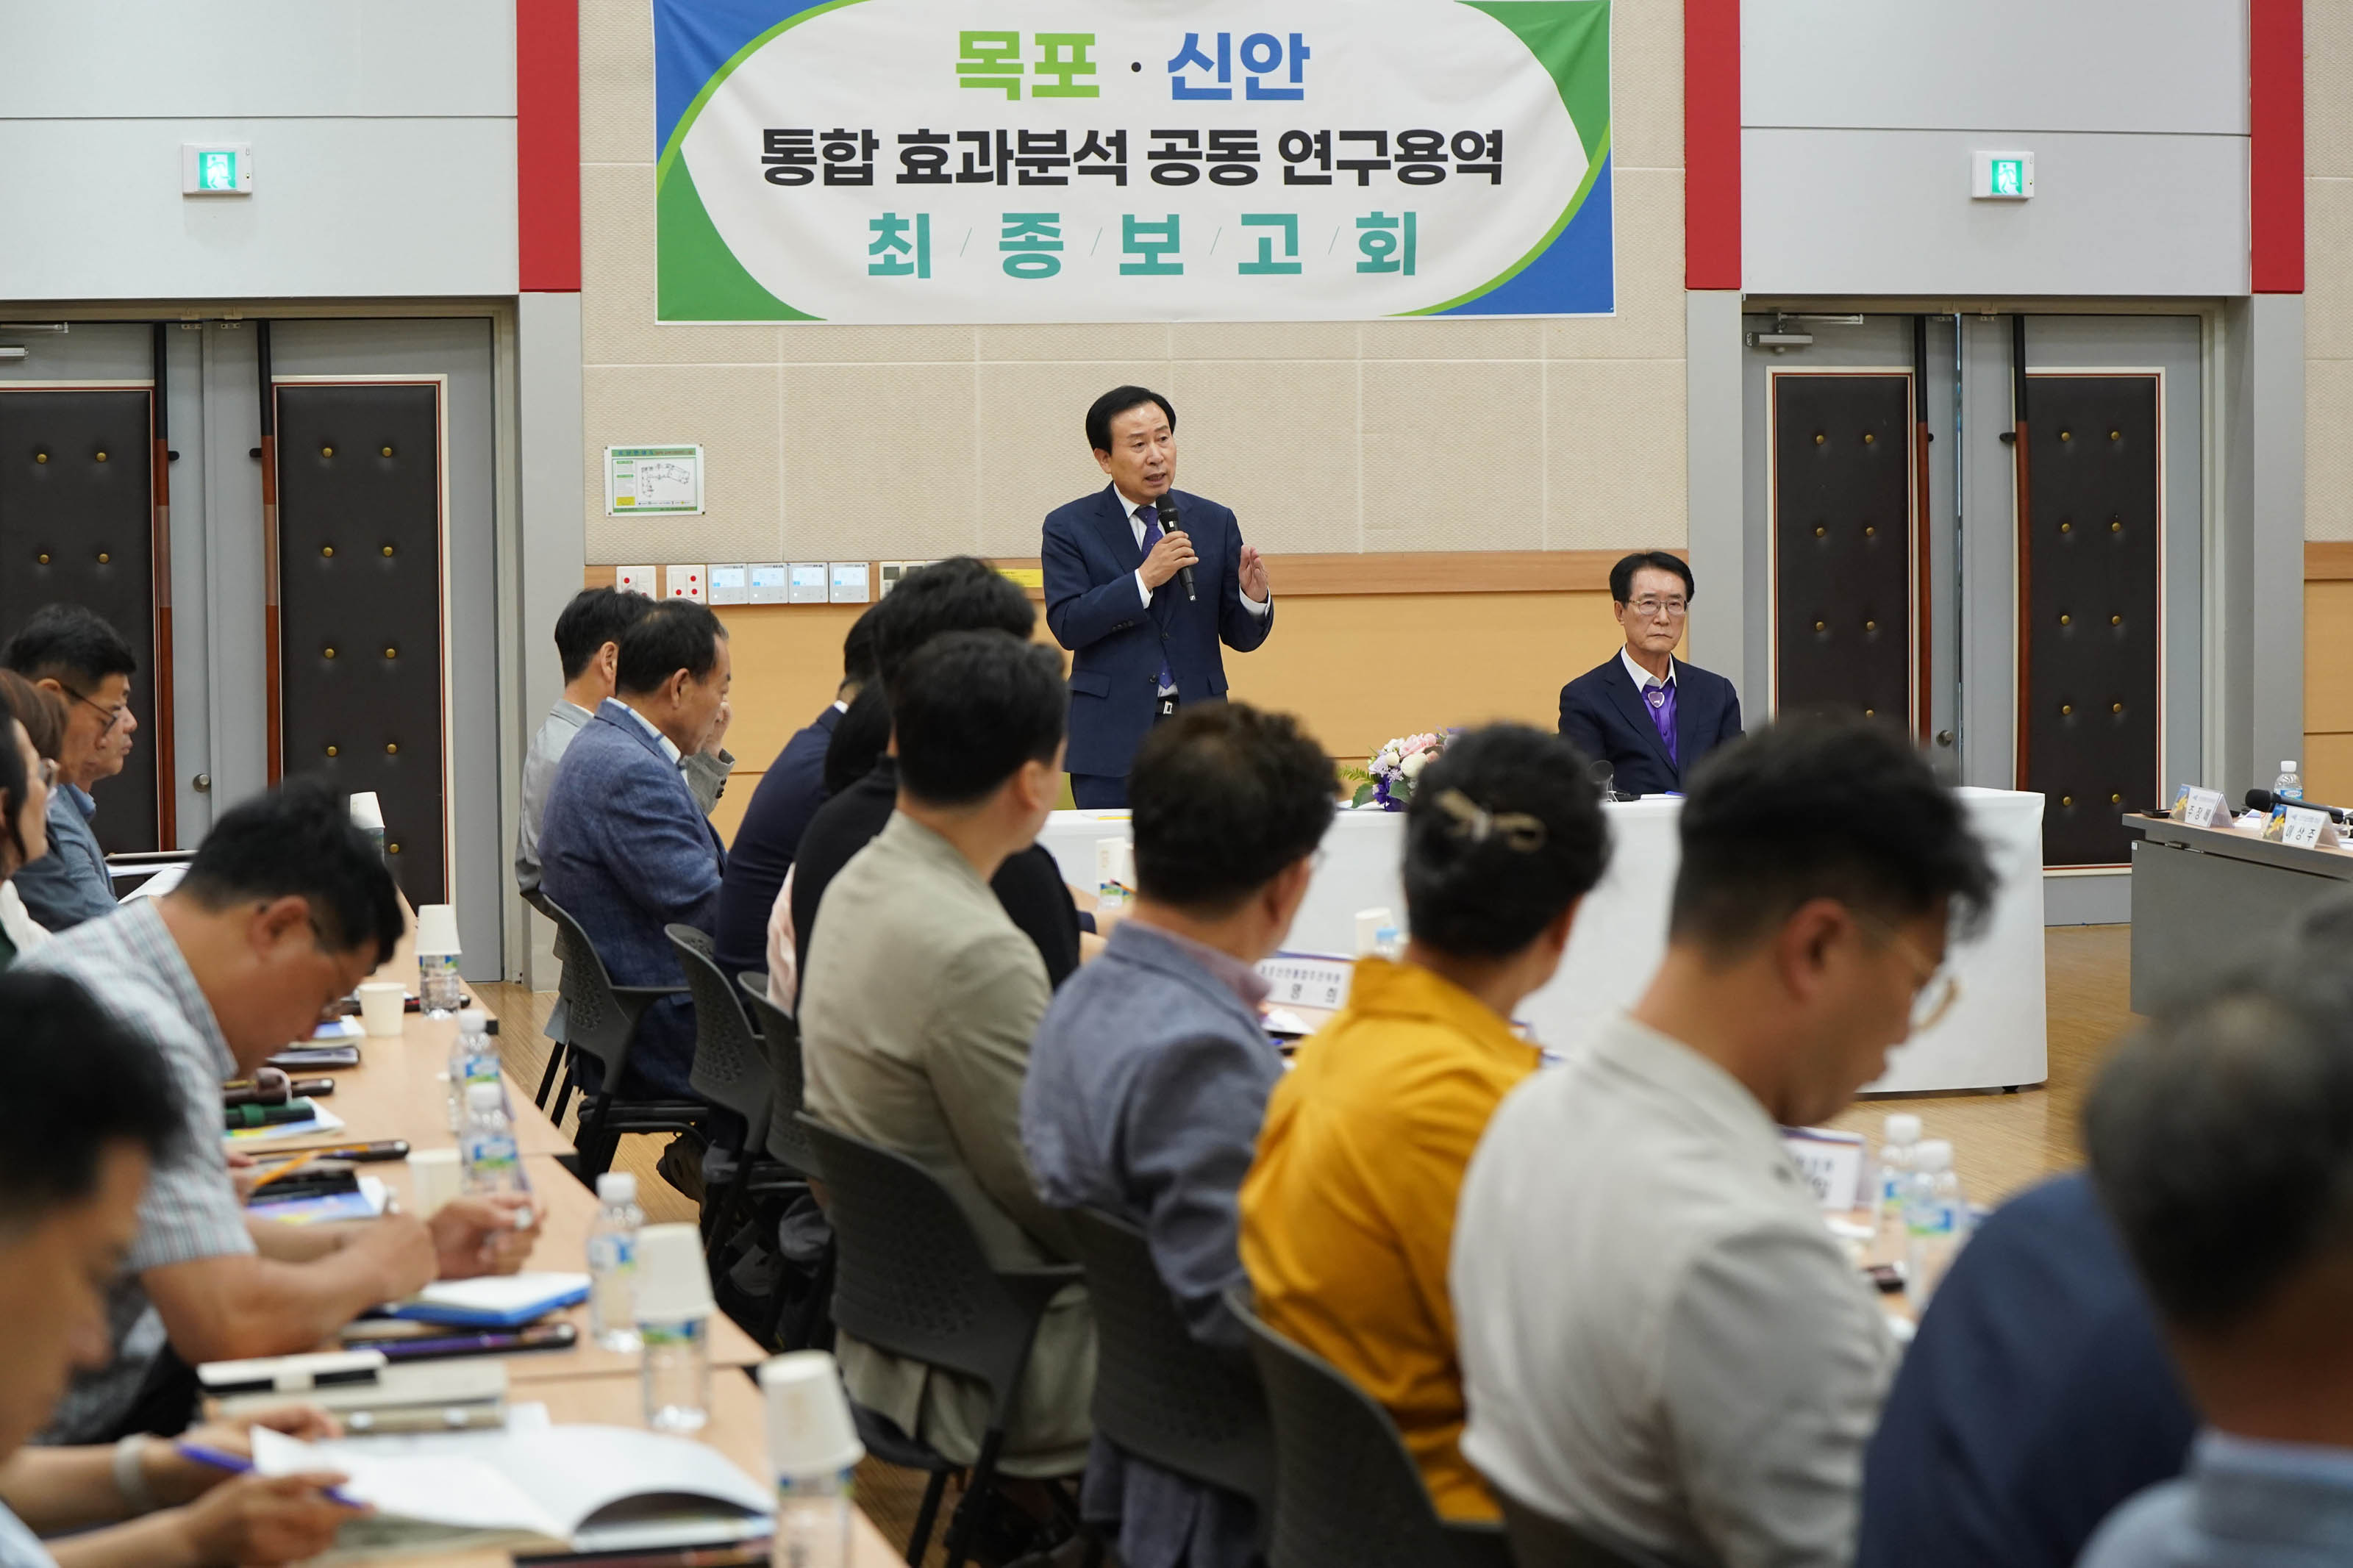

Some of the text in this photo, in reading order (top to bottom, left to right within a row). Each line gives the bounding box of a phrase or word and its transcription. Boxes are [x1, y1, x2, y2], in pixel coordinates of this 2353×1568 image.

[956, 31, 1099, 101] 목포
[1168, 32, 1311, 101] 신안
[762, 129, 1503, 187] 통합 효과분석 공동 연구용역
